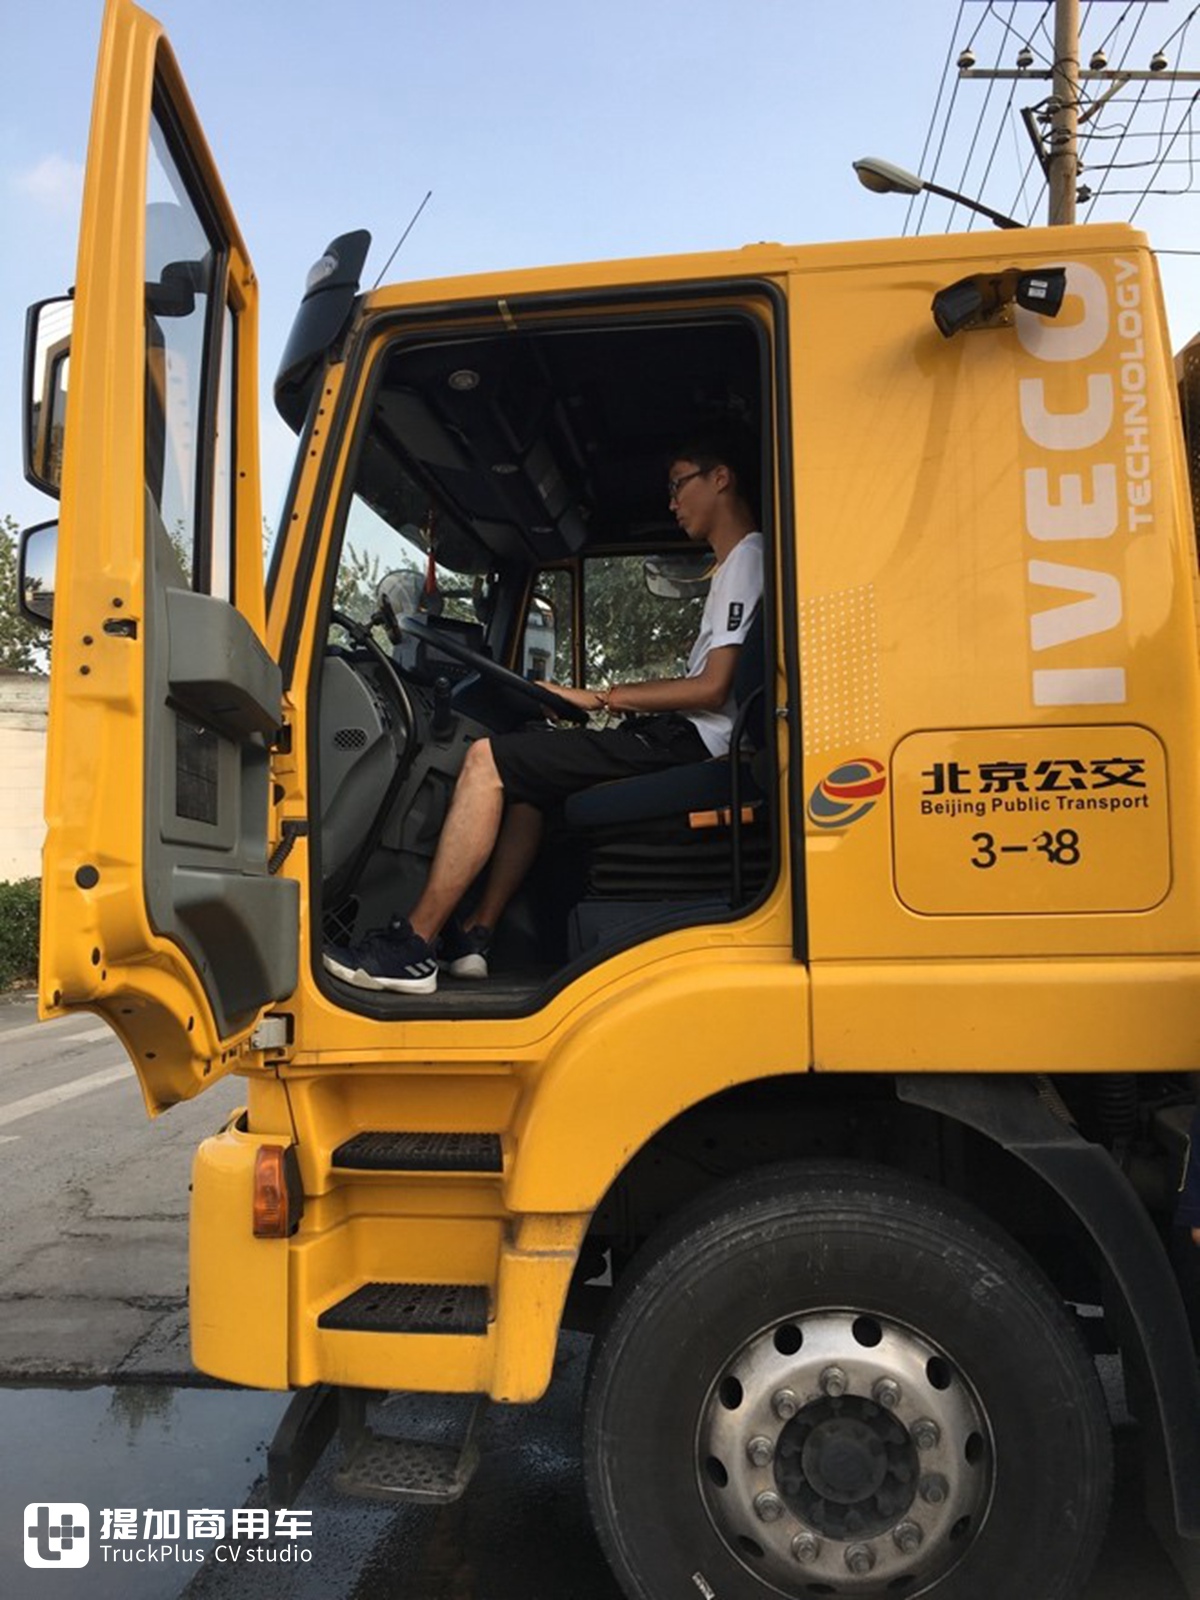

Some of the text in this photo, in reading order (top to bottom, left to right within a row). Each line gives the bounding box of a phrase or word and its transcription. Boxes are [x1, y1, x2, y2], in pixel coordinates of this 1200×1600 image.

[1113, 257, 1155, 533] TECHNOLOGY
[1014, 261, 1127, 706] IVECO
[920, 757, 1148, 796] 北京公交
[920, 793, 1149, 817] Beijing Public Transport
